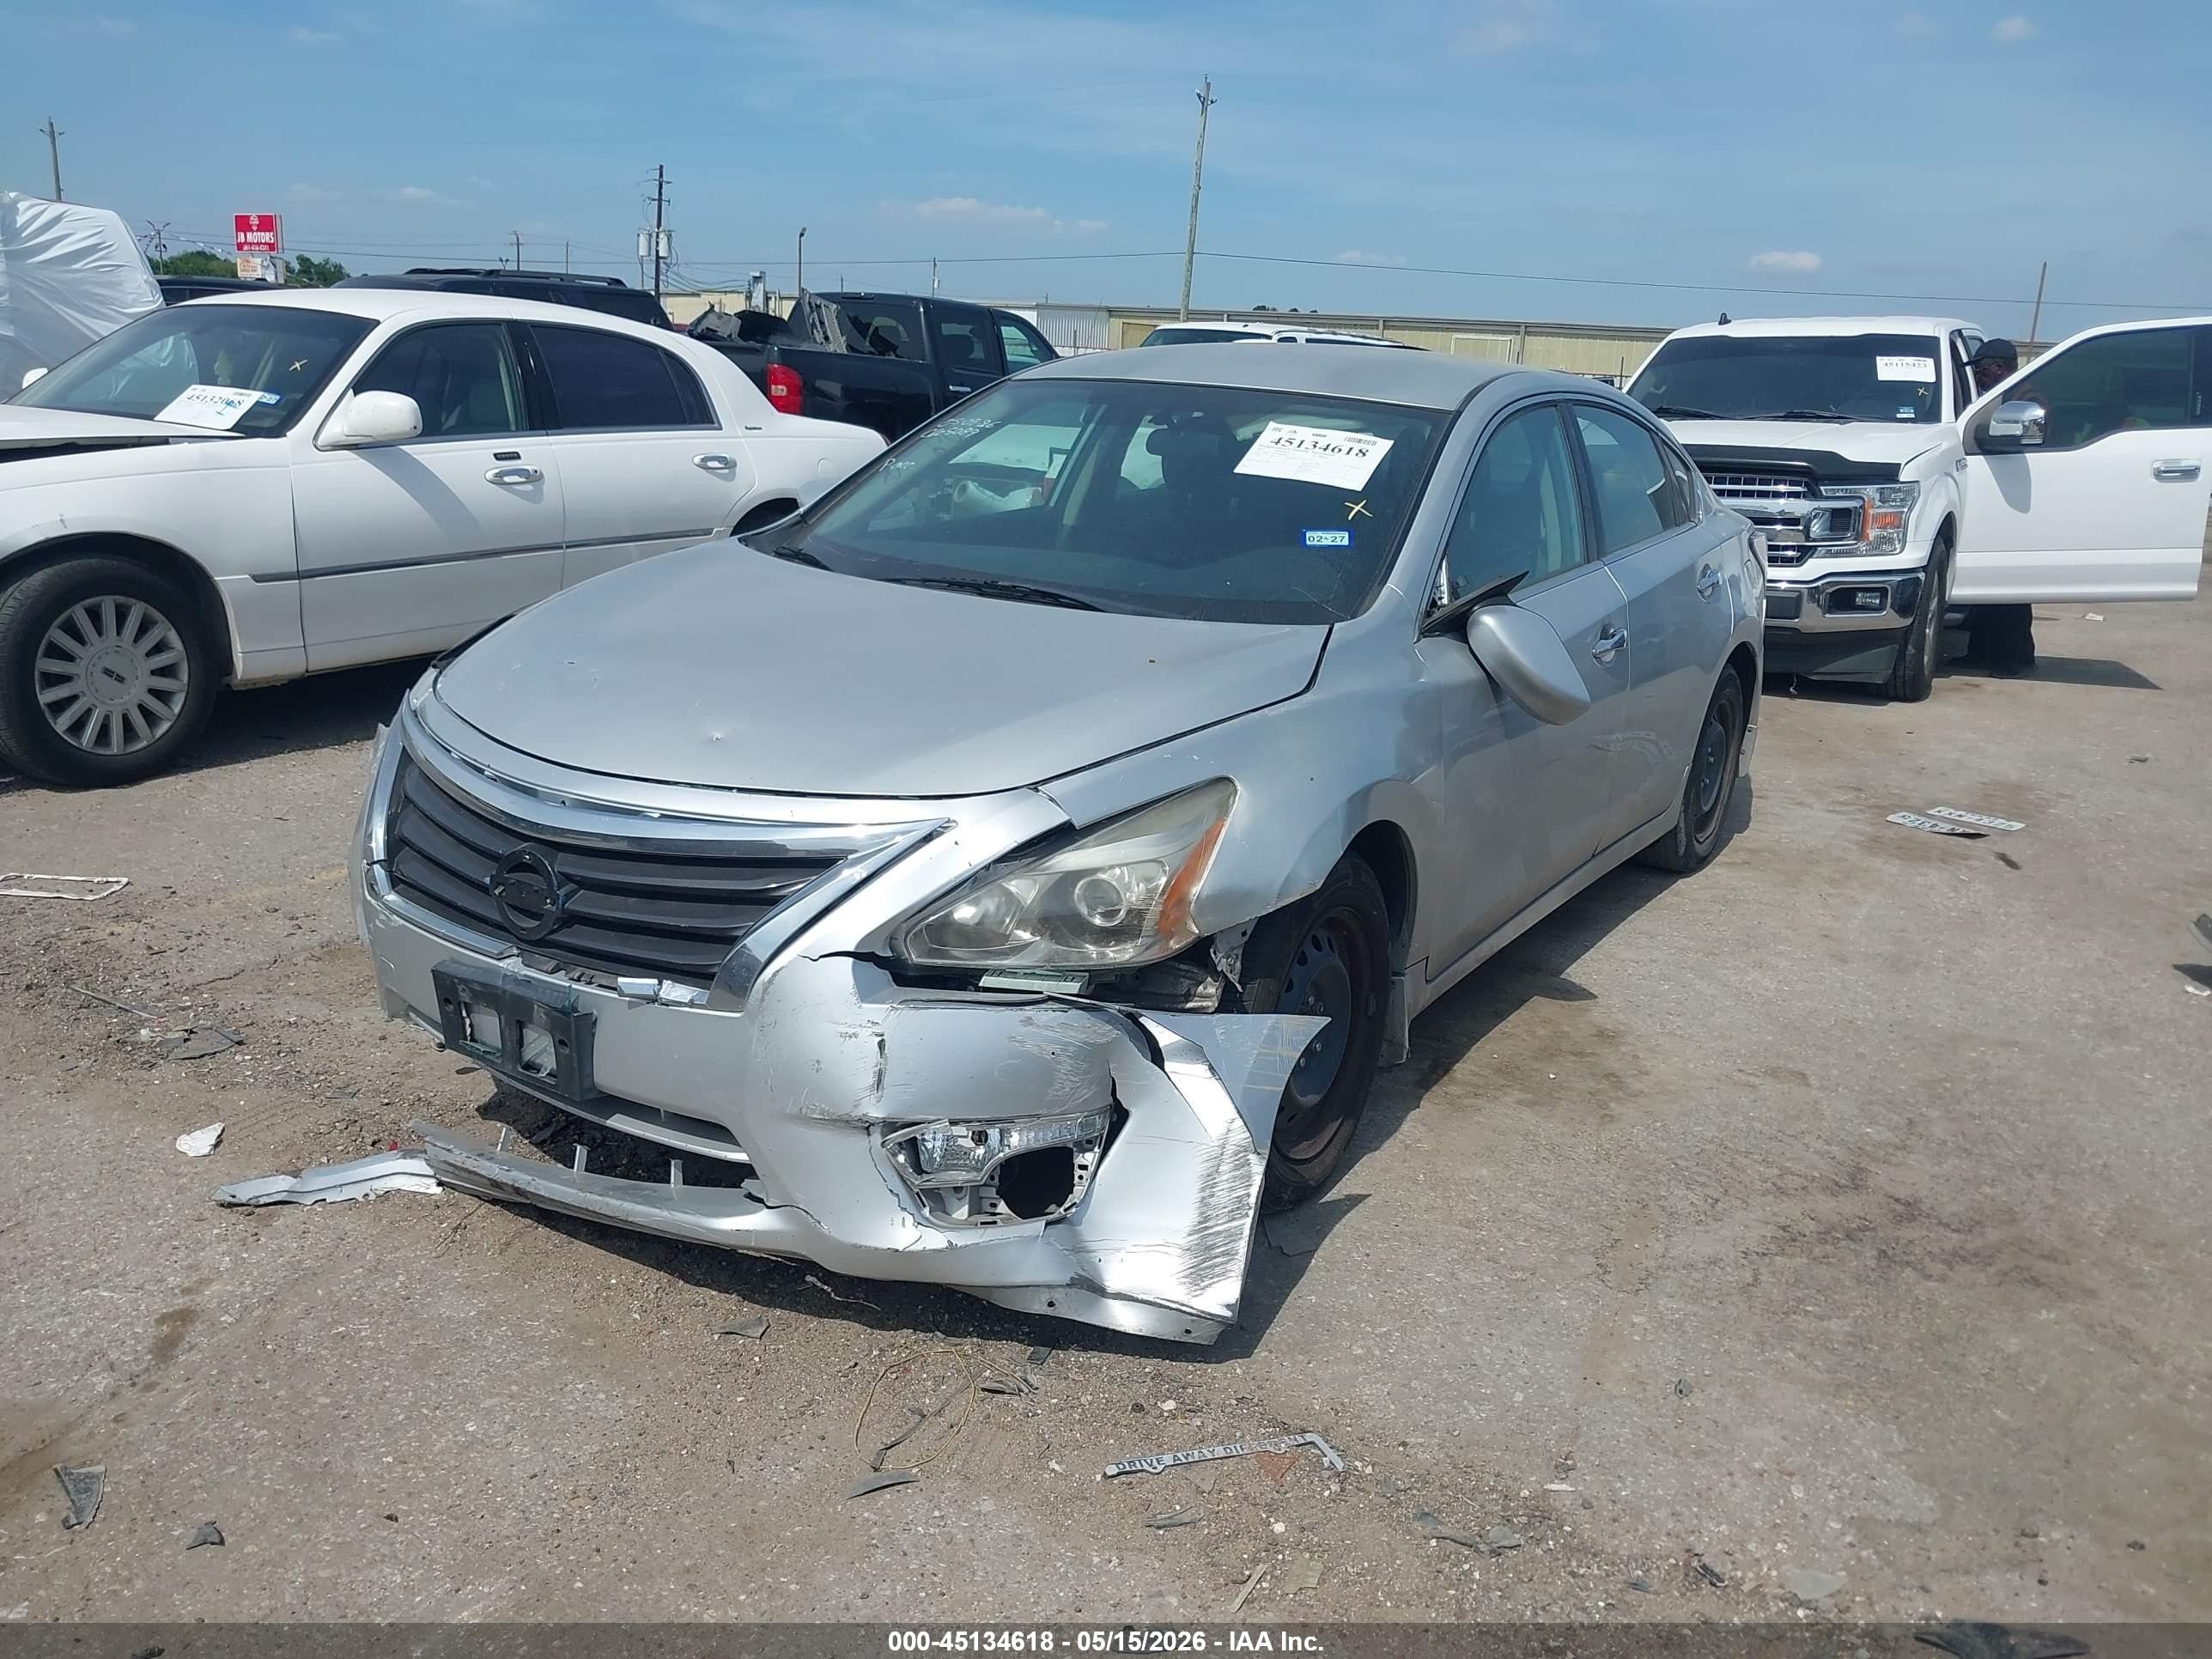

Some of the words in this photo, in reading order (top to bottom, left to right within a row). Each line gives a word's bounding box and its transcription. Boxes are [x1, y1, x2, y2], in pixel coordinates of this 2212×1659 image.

[237, 231, 246, 244] JB
[246, 231, 275, 244] MOTORS
[1270, 436, 1370, 458] 45134618
[1115, 1456, 1166, 1472] DRIVE
[1172, 1448, 1216, 1463] AWAY
